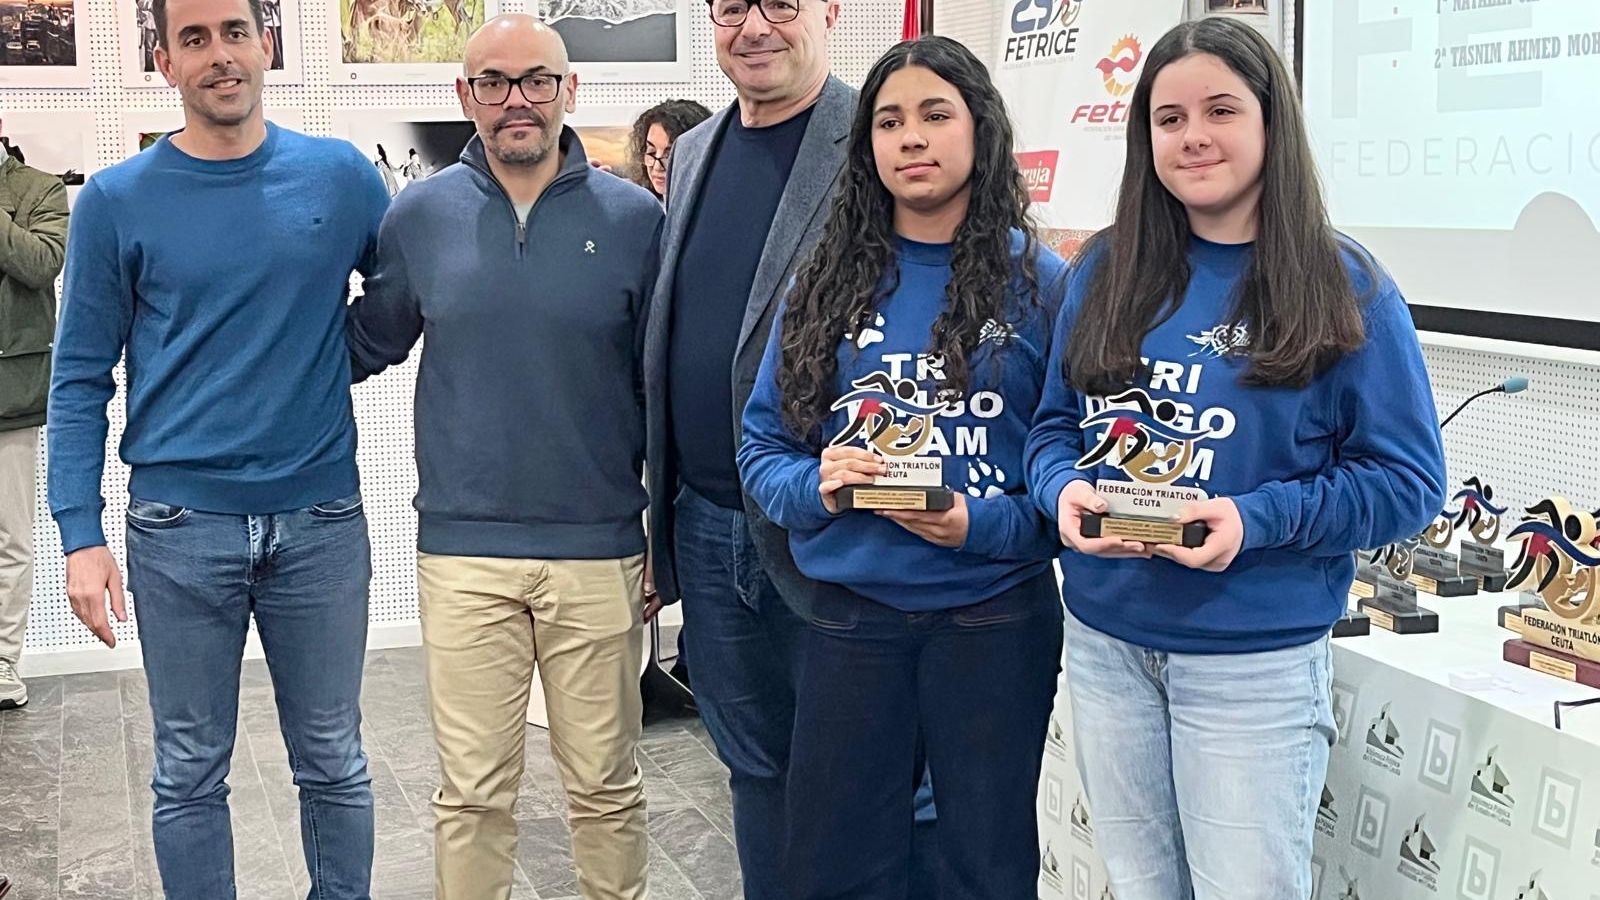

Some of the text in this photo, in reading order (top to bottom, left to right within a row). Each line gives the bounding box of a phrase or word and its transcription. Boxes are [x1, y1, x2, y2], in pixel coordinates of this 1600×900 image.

[1005, 28, 1079, 62] FETRICE
[1450, 42, 1502, 67] TASNIM
[1507, 36, 1561, 62] AHMED
[1019, 160, 1050, 190] ruja
[882, 353, 947, 381] TR
[1133, 498, 1161, 507] CEUTA
[1551, 635, 1574, 651] CEUTA
[1568, 627, 1600, 646] TRIATLÓ
